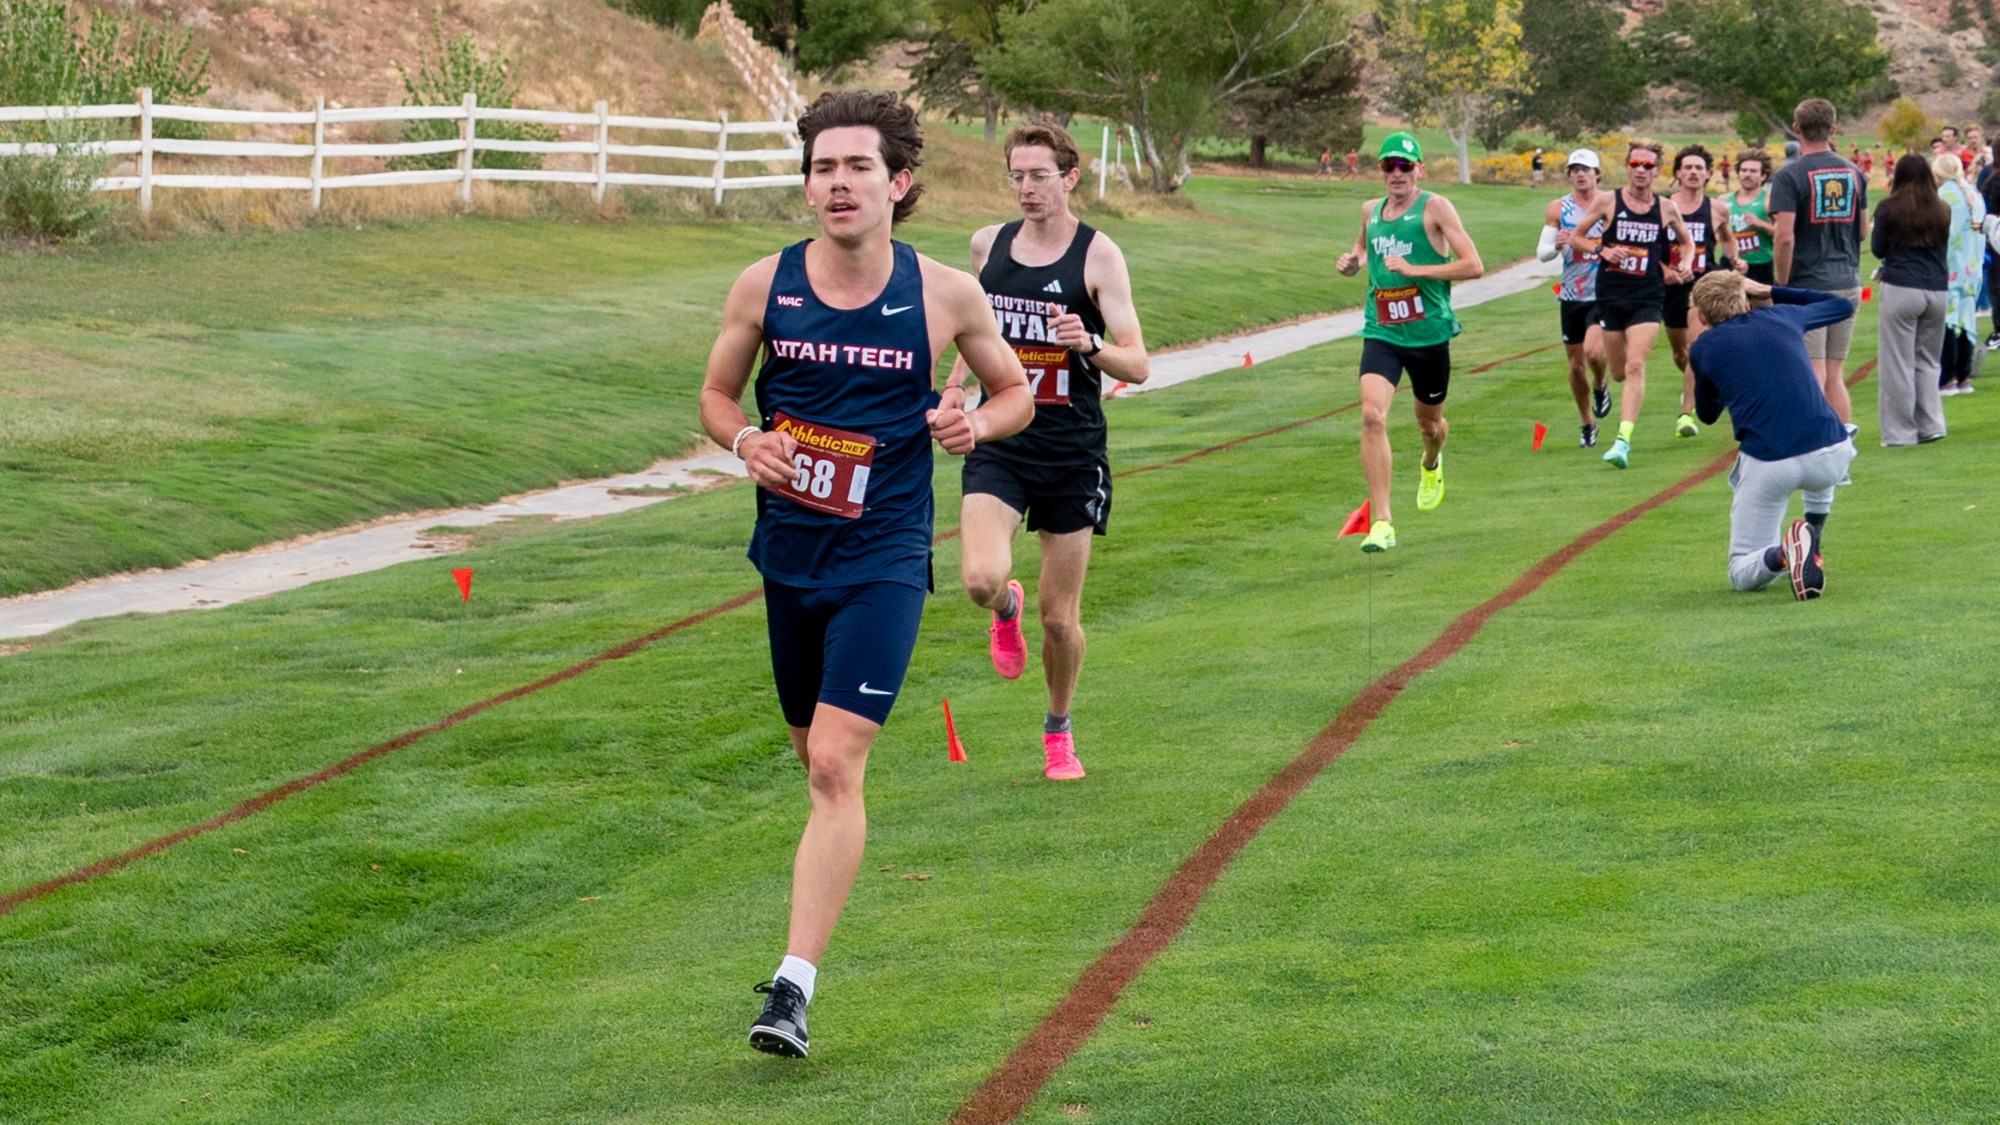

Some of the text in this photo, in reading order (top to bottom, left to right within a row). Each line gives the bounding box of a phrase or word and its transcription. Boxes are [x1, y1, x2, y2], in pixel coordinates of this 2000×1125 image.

[1616, 220, 1659, 230] SOUTHERN
[1371, 234, 1396, 255] Utah
[1616, 229, 1658, 243] UTAH
[1619, 256, 1638, 271] 93
[776, 295, 803, 307] WAC
[1388, 300, 1410, 320] 90
[772, 339, 913, 370] UTAH TECH
[1023, 368, 1045, 396] 7
[843, 443, 869, 455] NET
[790, 453, 836, 499] 68
